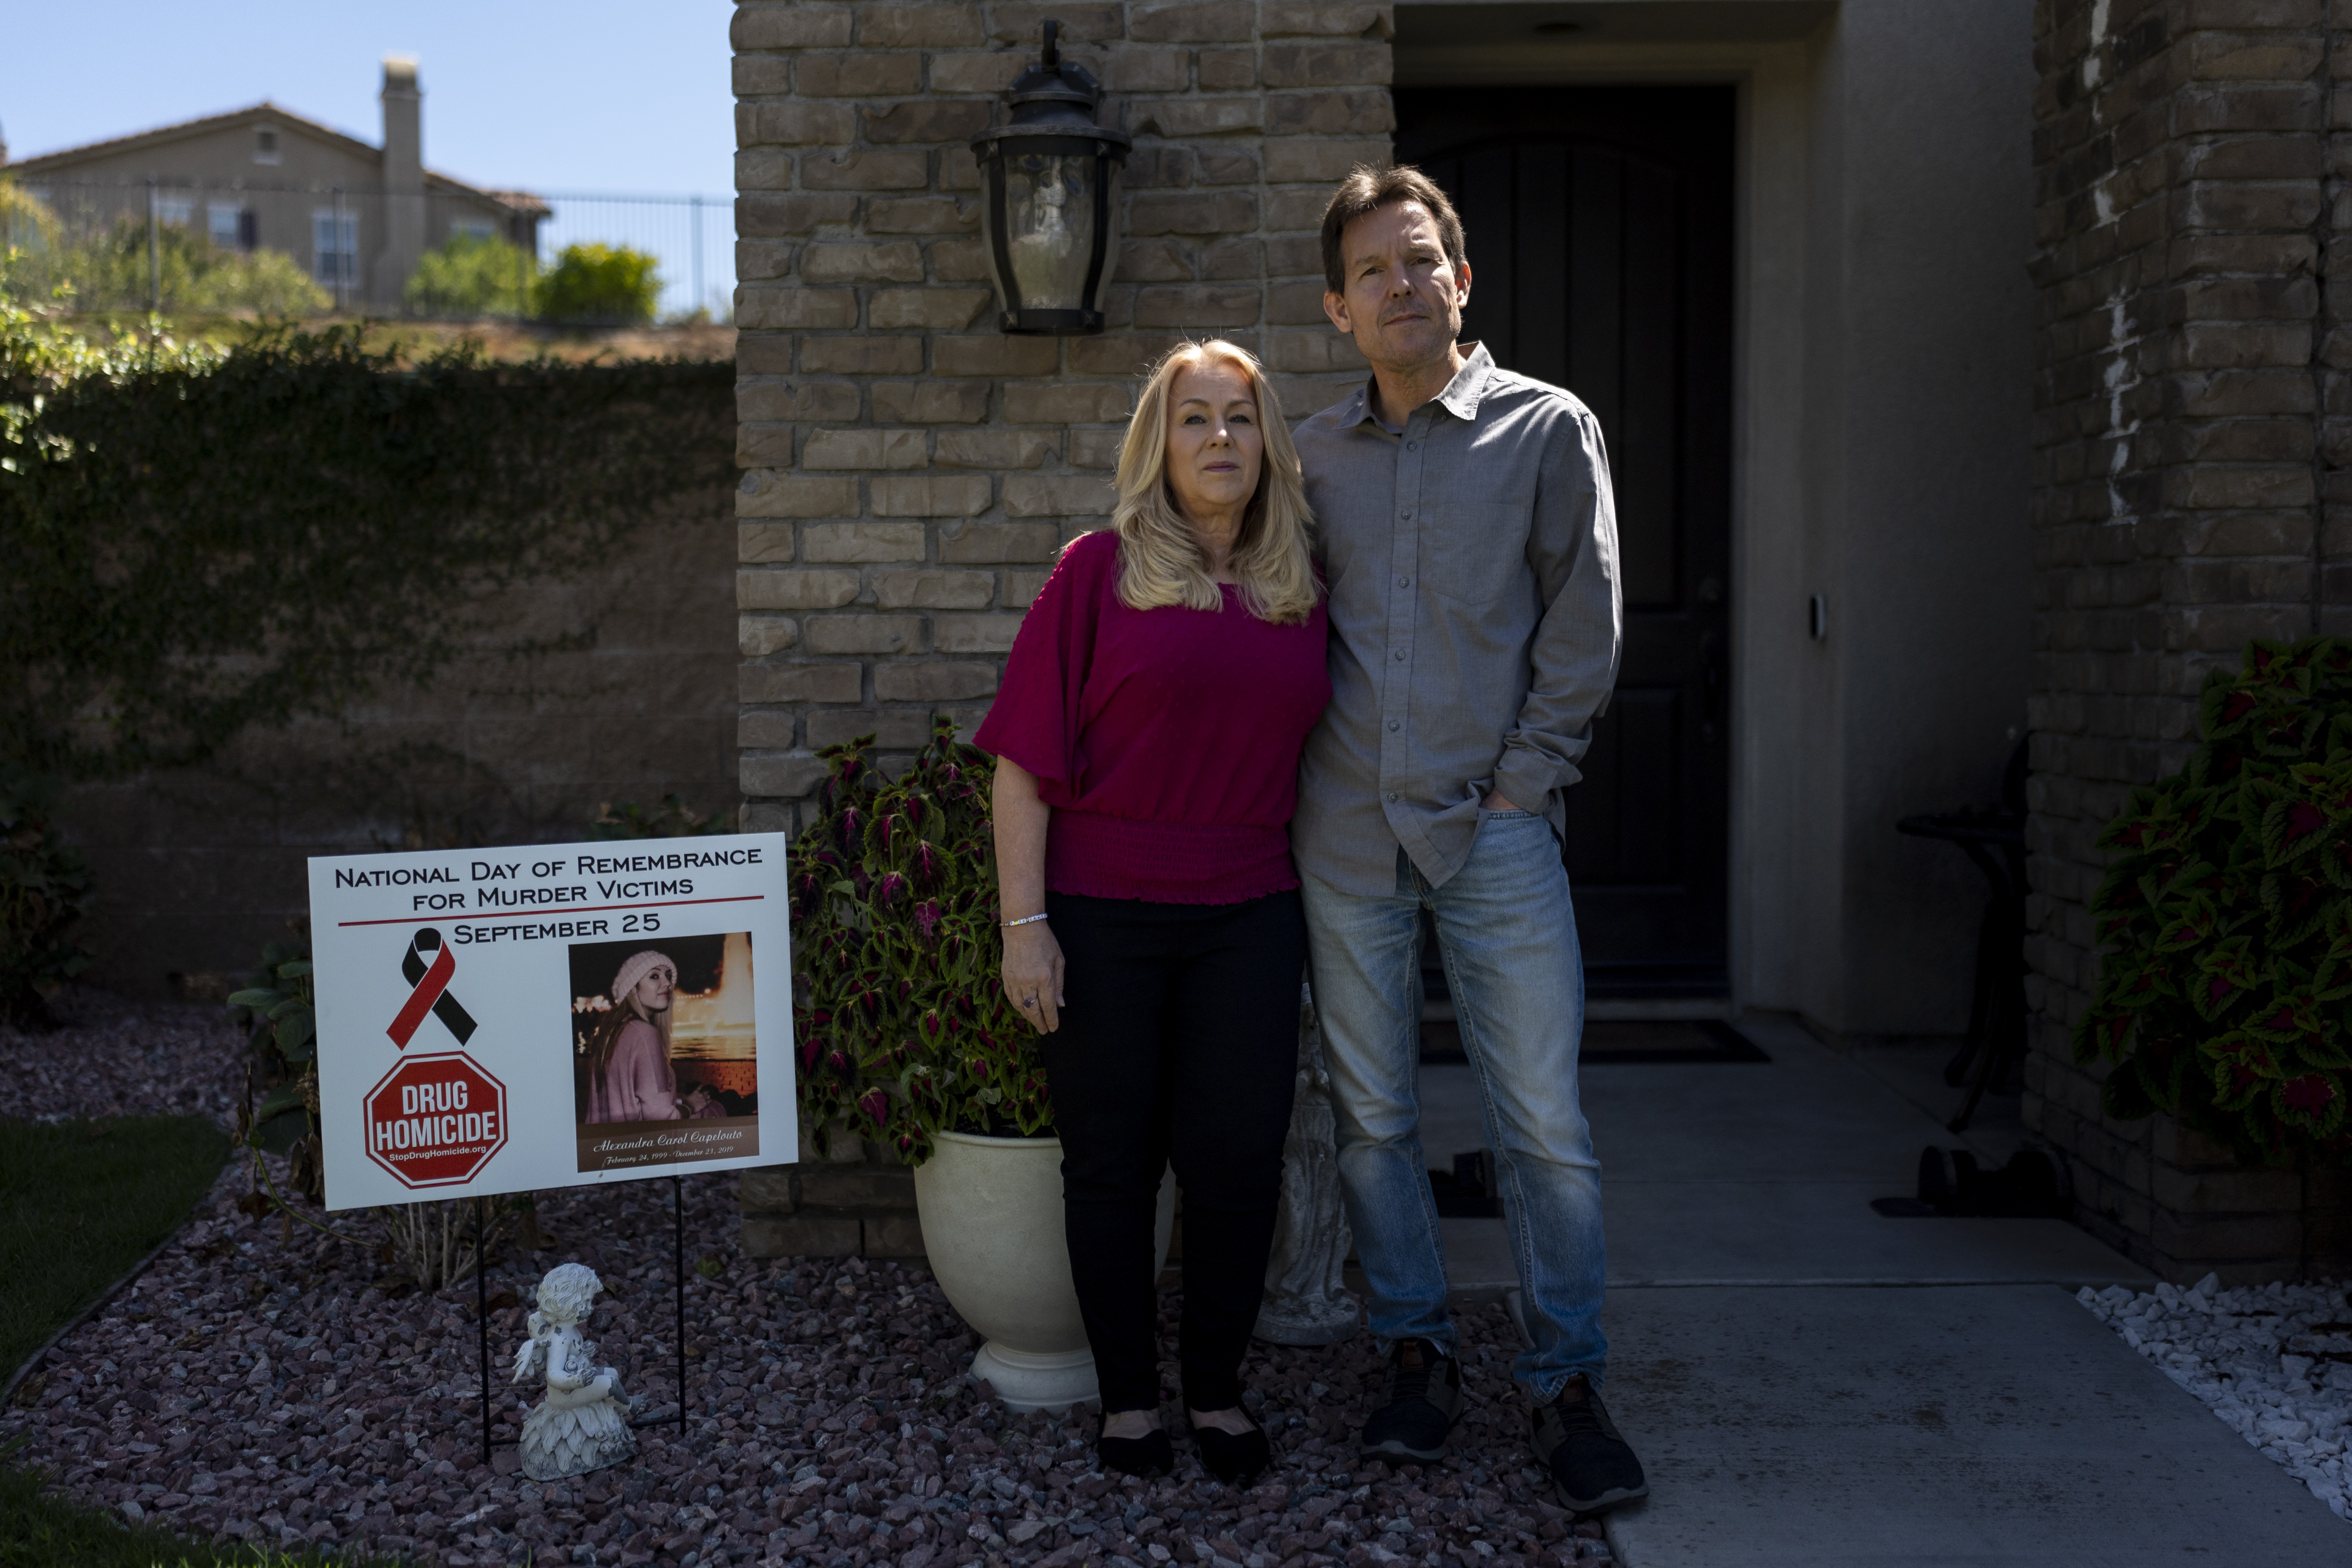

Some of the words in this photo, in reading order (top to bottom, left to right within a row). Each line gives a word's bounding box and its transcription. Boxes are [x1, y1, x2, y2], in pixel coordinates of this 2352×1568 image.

[622, 913, 661, 933] 25
[402, 1081, 468, 1115] DRUG
[376, 1111, 497, 1151] HOMICIDE
[593, 1137, 655, 1152] Alexandra
[657, 1132, 688, 1146] Carol
[690, 1129, 743, 1144] Capelouto
[389, 1146, 486, 1161] StopDrugHomicide.org
[604, 1156, 637, 1165] February
[673, 1149, 704, 1158] December
